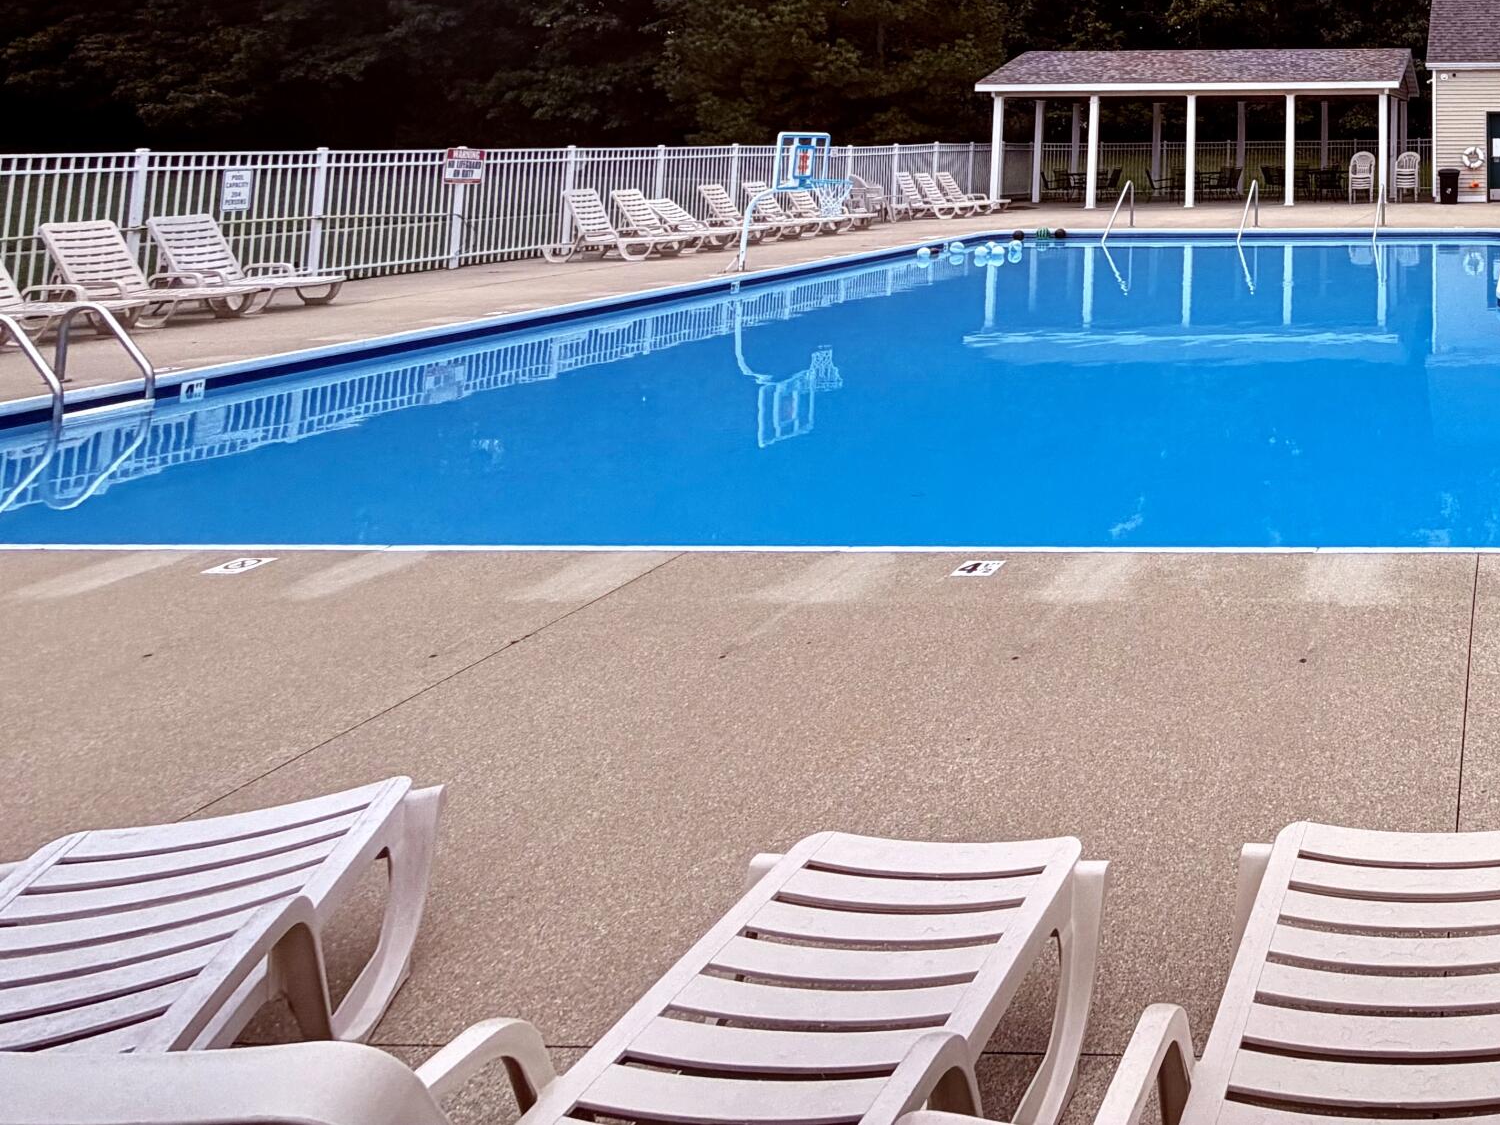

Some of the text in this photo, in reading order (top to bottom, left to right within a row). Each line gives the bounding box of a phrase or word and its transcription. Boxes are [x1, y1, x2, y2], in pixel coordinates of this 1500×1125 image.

[453, 150, 480, 159] WARNING
[456, 161, 481, 169] LIFEGUARD
[186, 383, 194, 399] 4
[958, 562, 982, 573] 4
